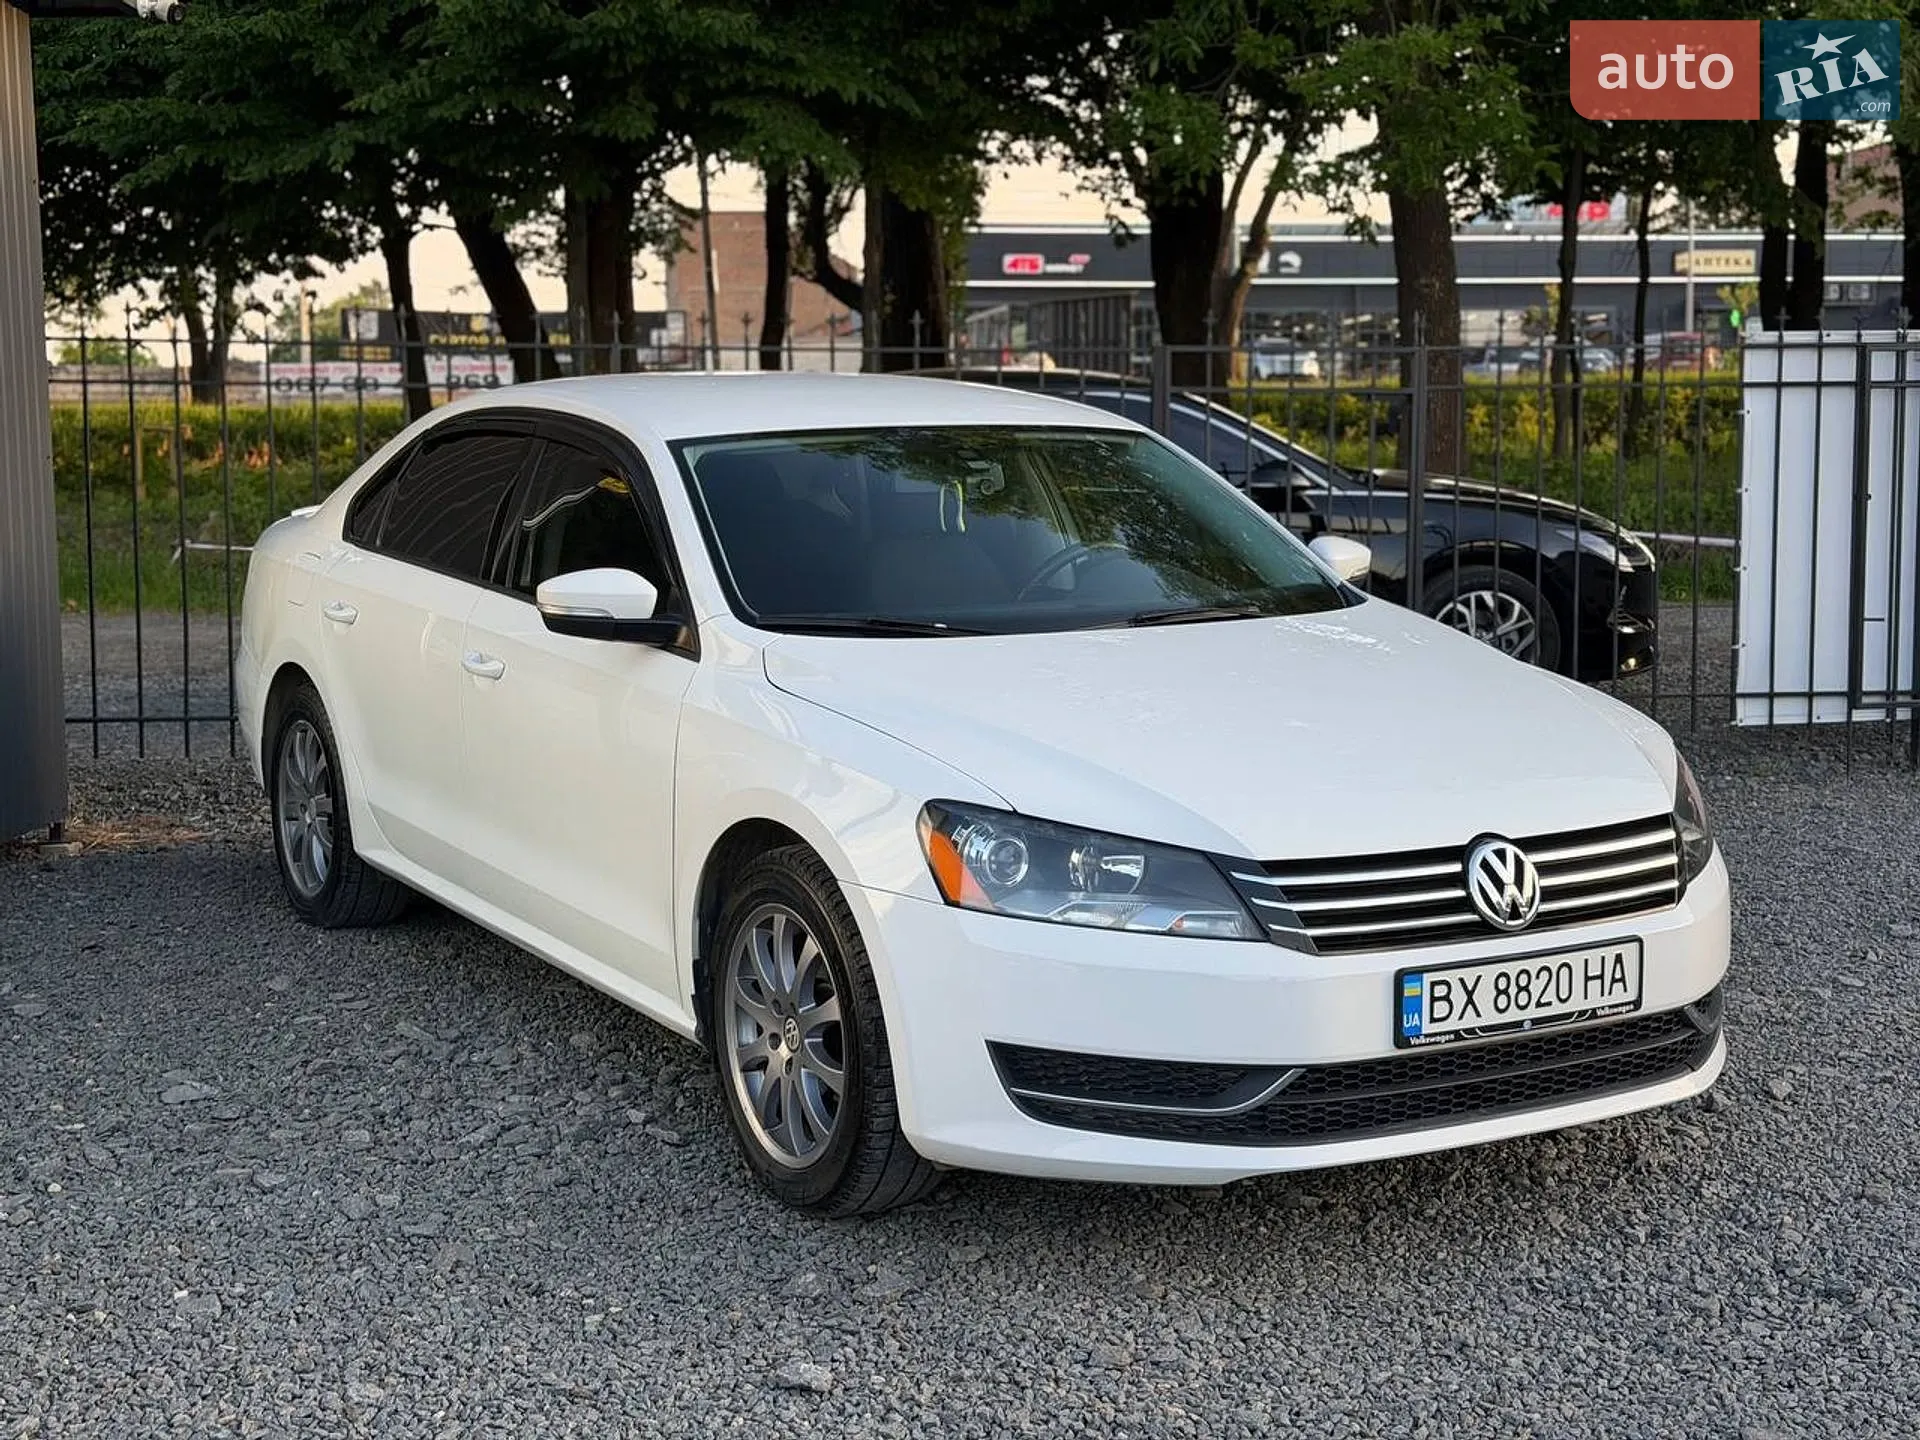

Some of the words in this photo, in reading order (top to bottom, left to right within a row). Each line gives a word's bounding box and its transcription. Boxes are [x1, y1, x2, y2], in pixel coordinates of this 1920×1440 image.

[1428, 974, 1483, 1025] BX
[1493, 961, 1574, 1014] 8820
[1583, 952, 1629, 1000] HA
[1403, 1011, 1421, 1028] UA
[1409, 1032, 1456, 1046] Volkswagen
